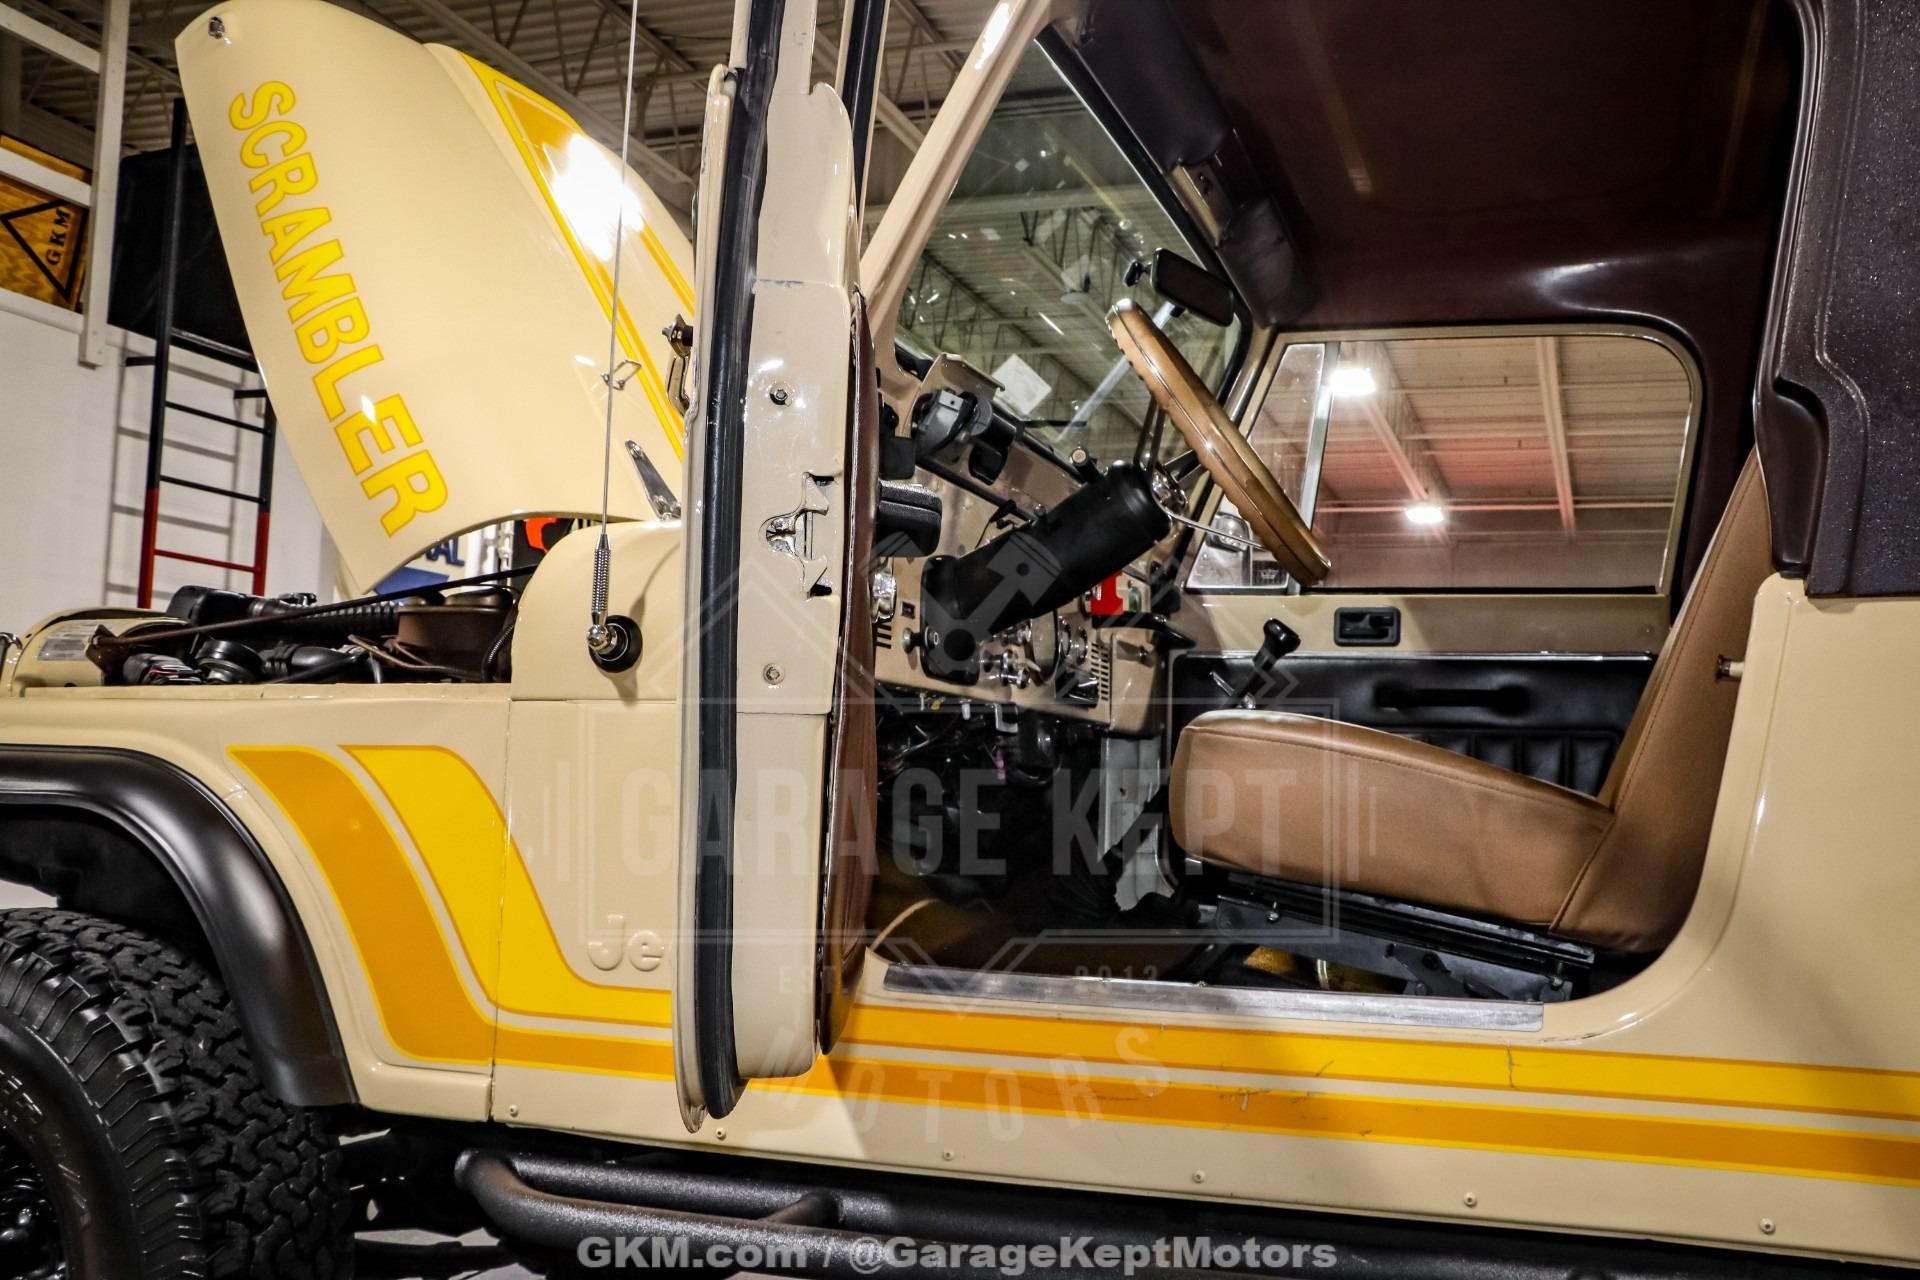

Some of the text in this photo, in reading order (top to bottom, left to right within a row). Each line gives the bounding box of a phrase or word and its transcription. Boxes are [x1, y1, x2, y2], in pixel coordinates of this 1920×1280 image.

[45, 207, 72, 265] GKM
[228, 80, 448, 539] SCRAMBLER
[587, 914, 672, 972] Je
